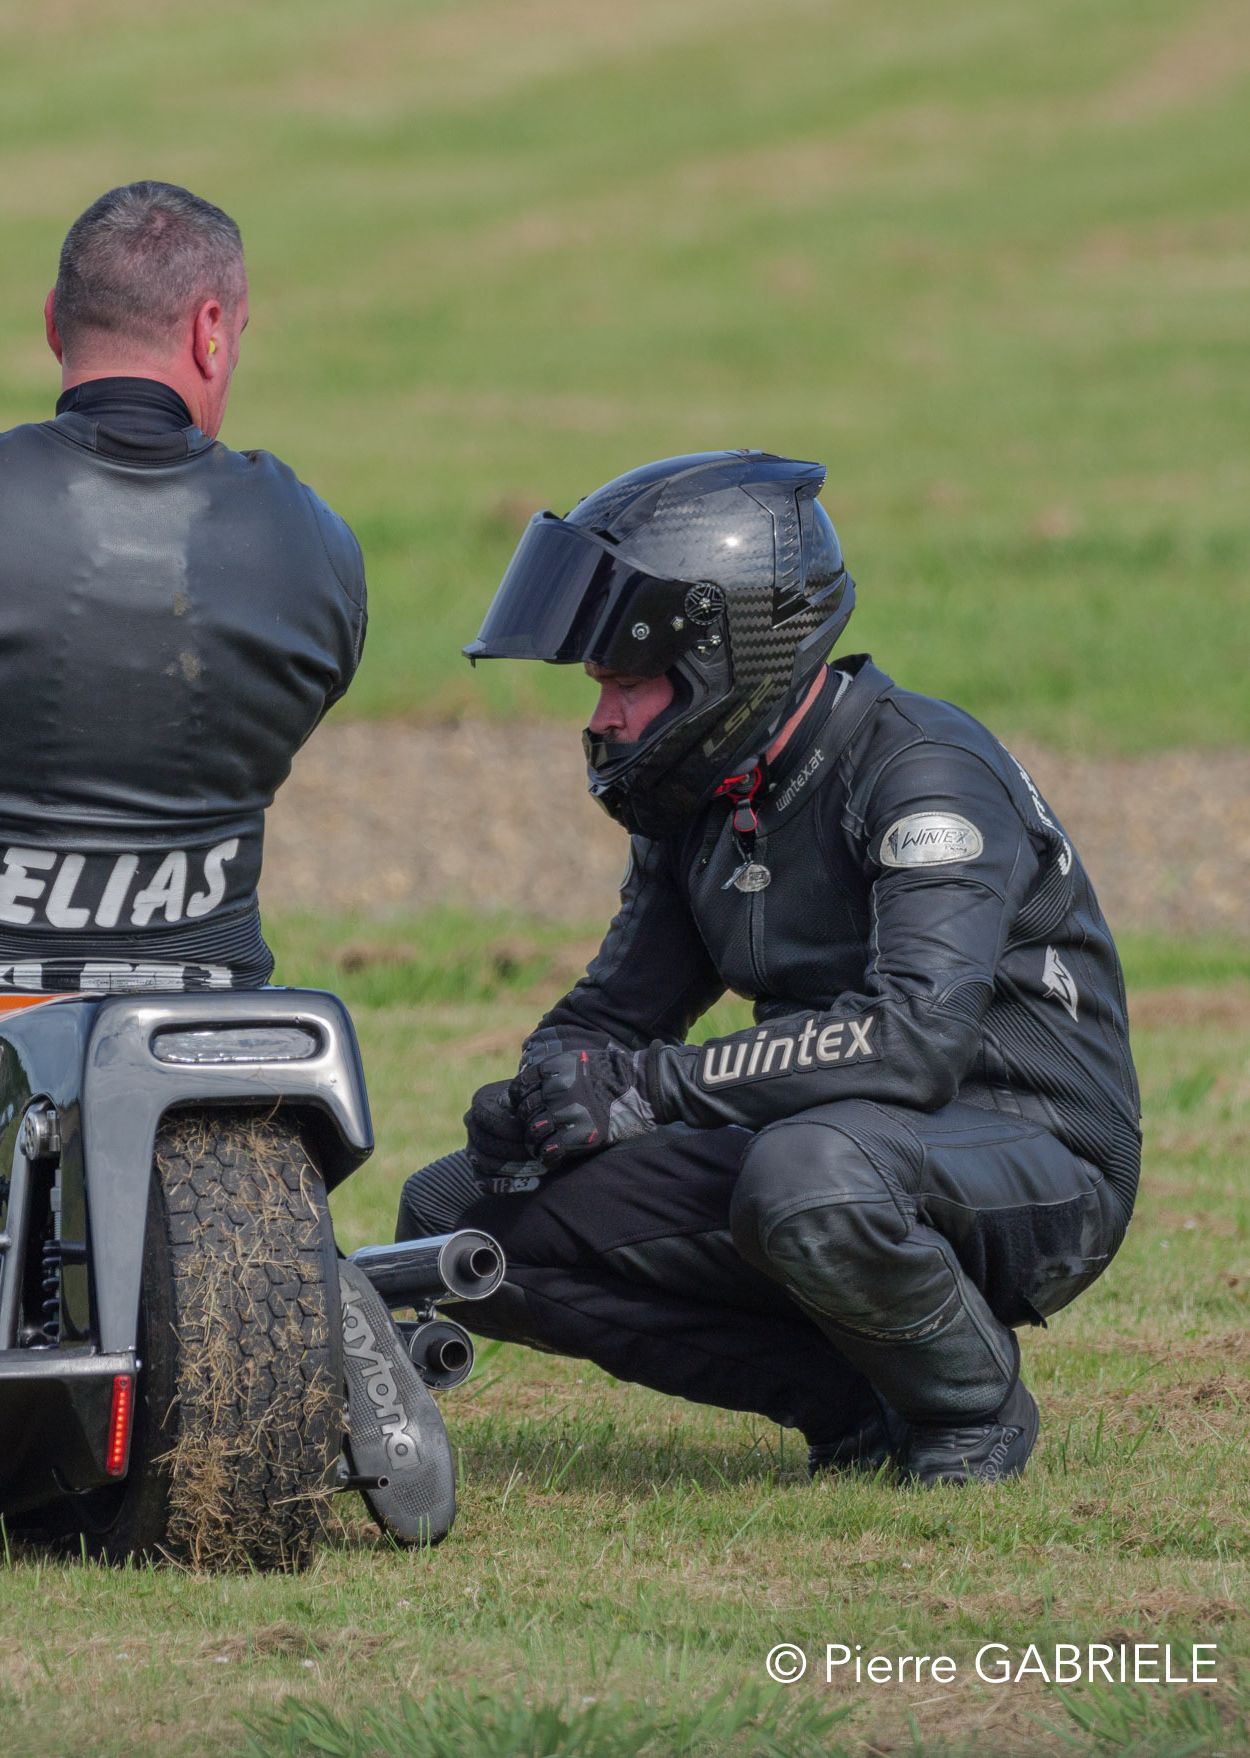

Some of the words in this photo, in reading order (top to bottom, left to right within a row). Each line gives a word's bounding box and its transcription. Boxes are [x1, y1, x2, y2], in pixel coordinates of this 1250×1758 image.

[703, 675, 775, 757] LS2
[776, 748, 824, 811] wintex.at
[901, 828, 970, 849] WINTEX
[703, 1015, 874, 1085] wintex
